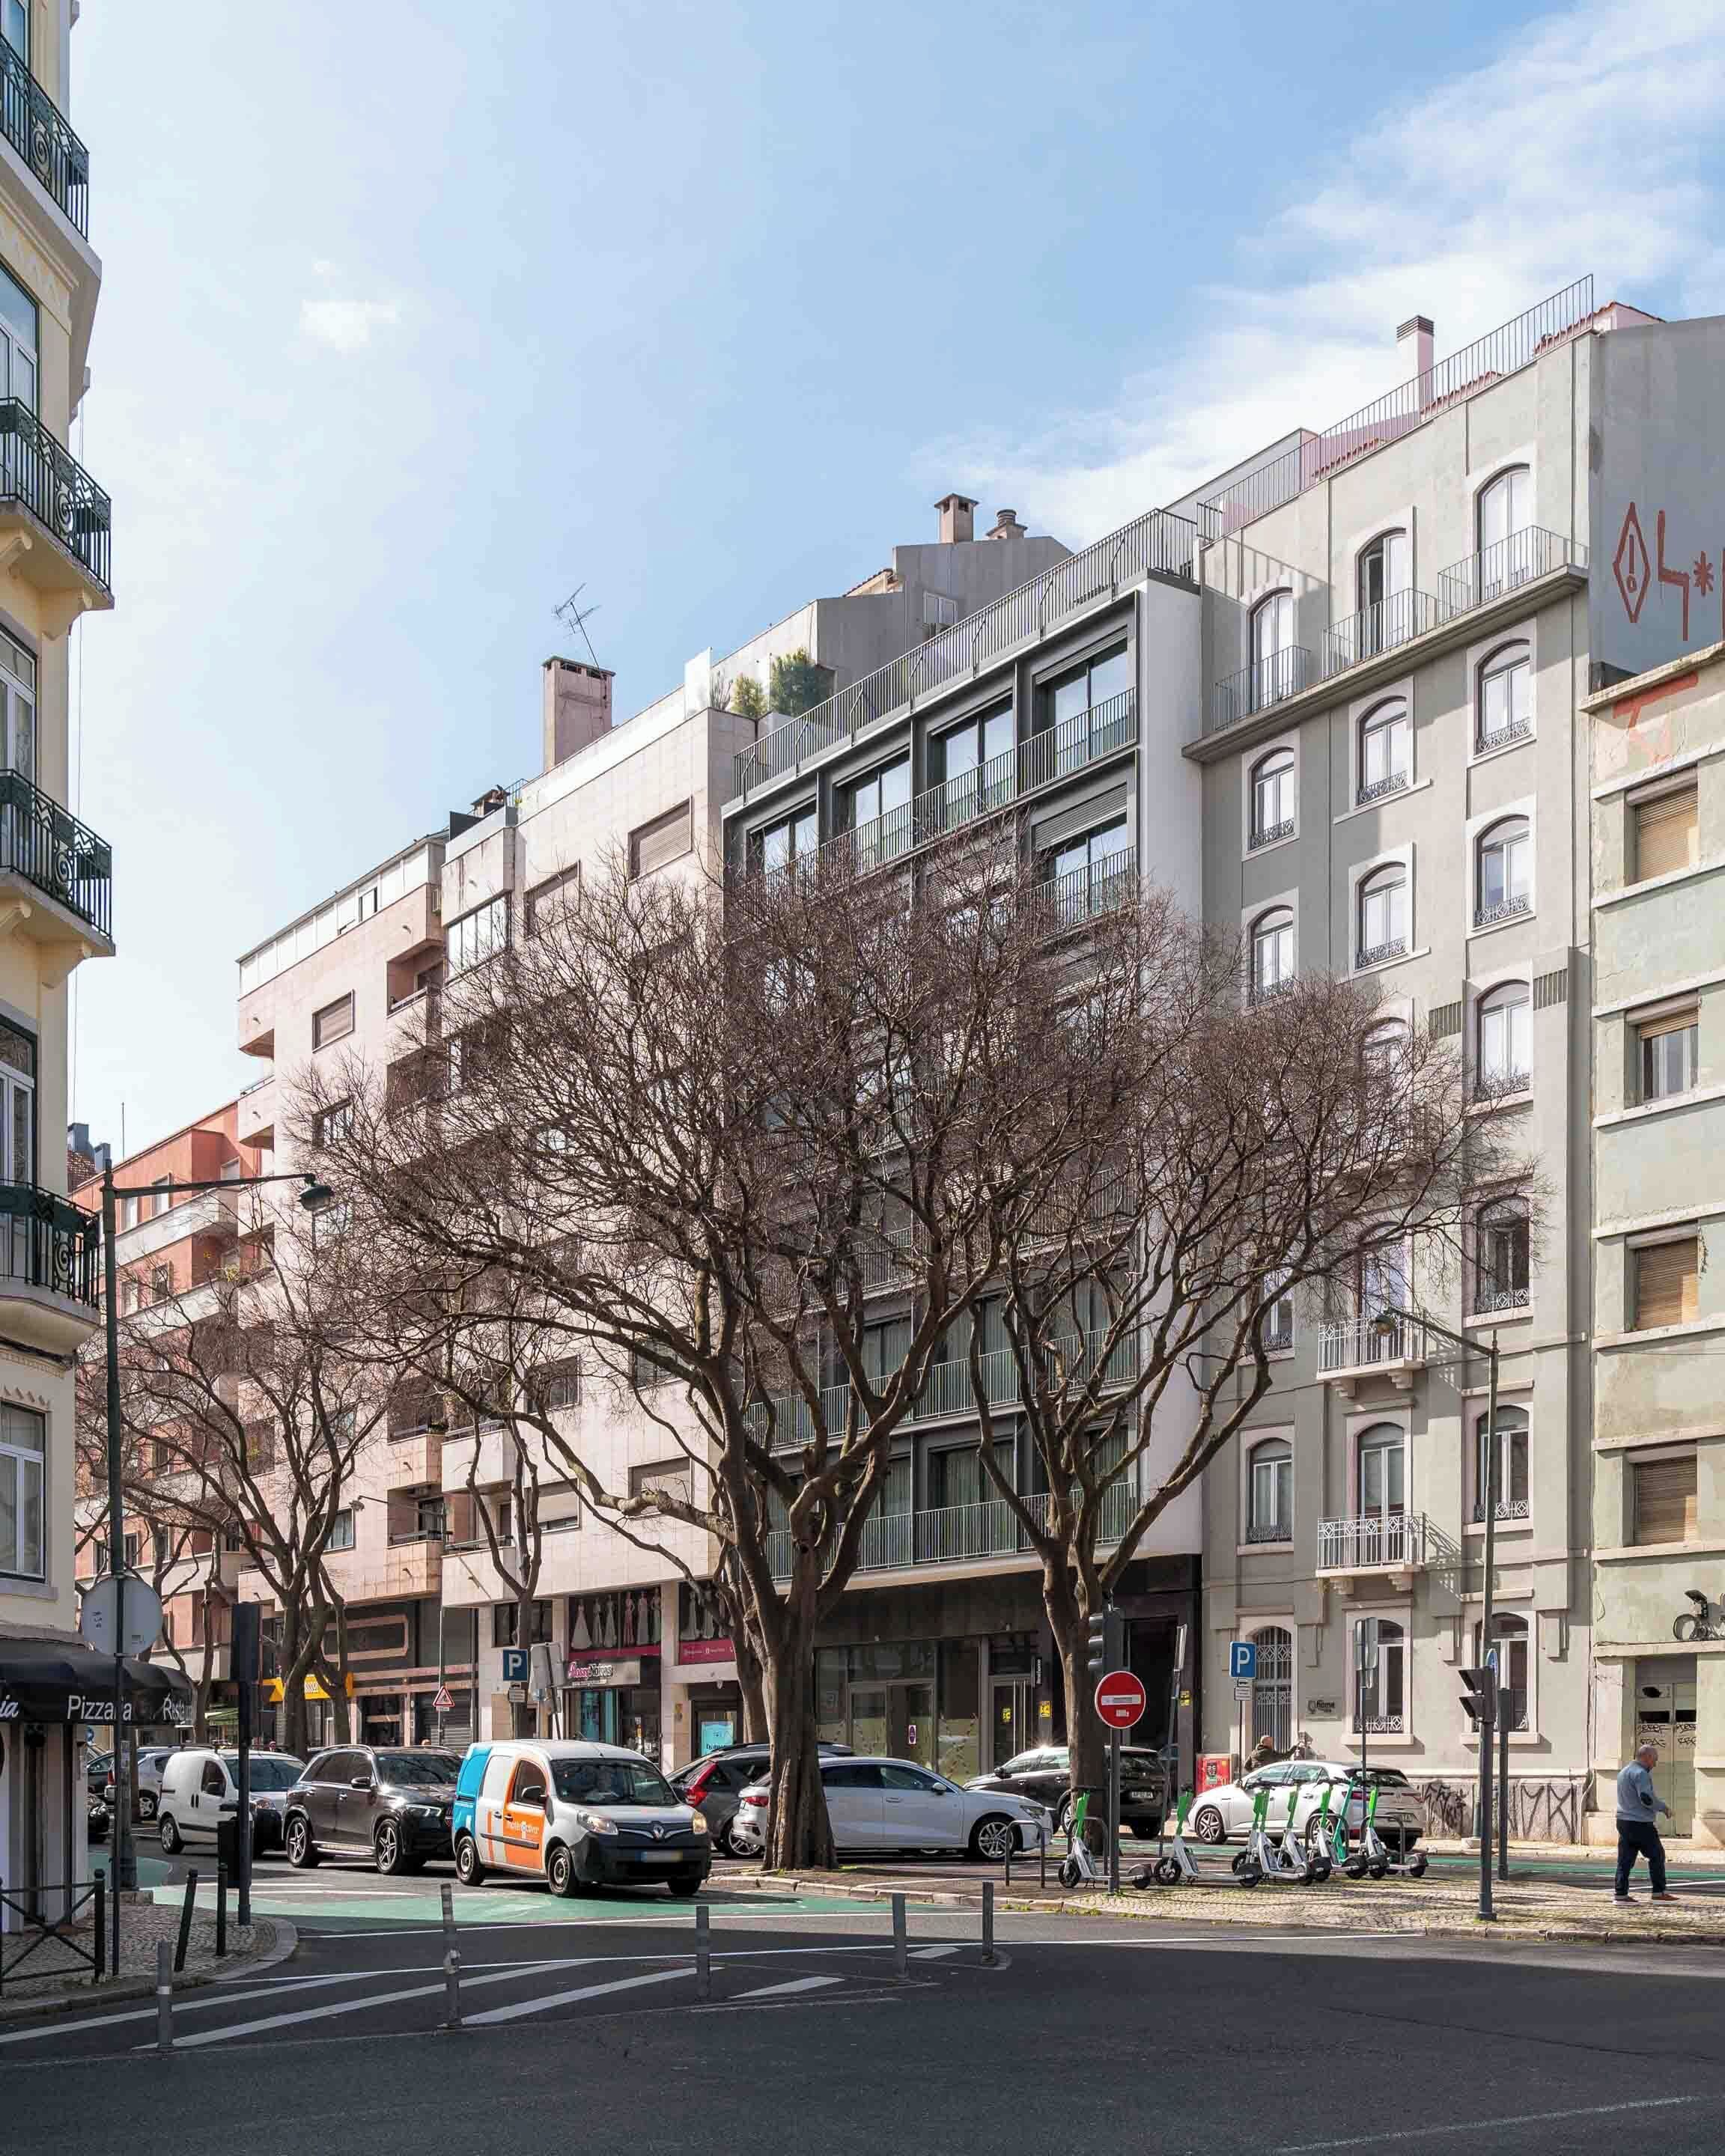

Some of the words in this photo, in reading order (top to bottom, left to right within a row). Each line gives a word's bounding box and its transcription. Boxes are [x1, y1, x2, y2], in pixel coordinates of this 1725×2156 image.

[509, 1653, 522, 1677] P
[1237, 1647, 1250, 1673] P
[67, 1695, 133, 1721] Pizzaa
